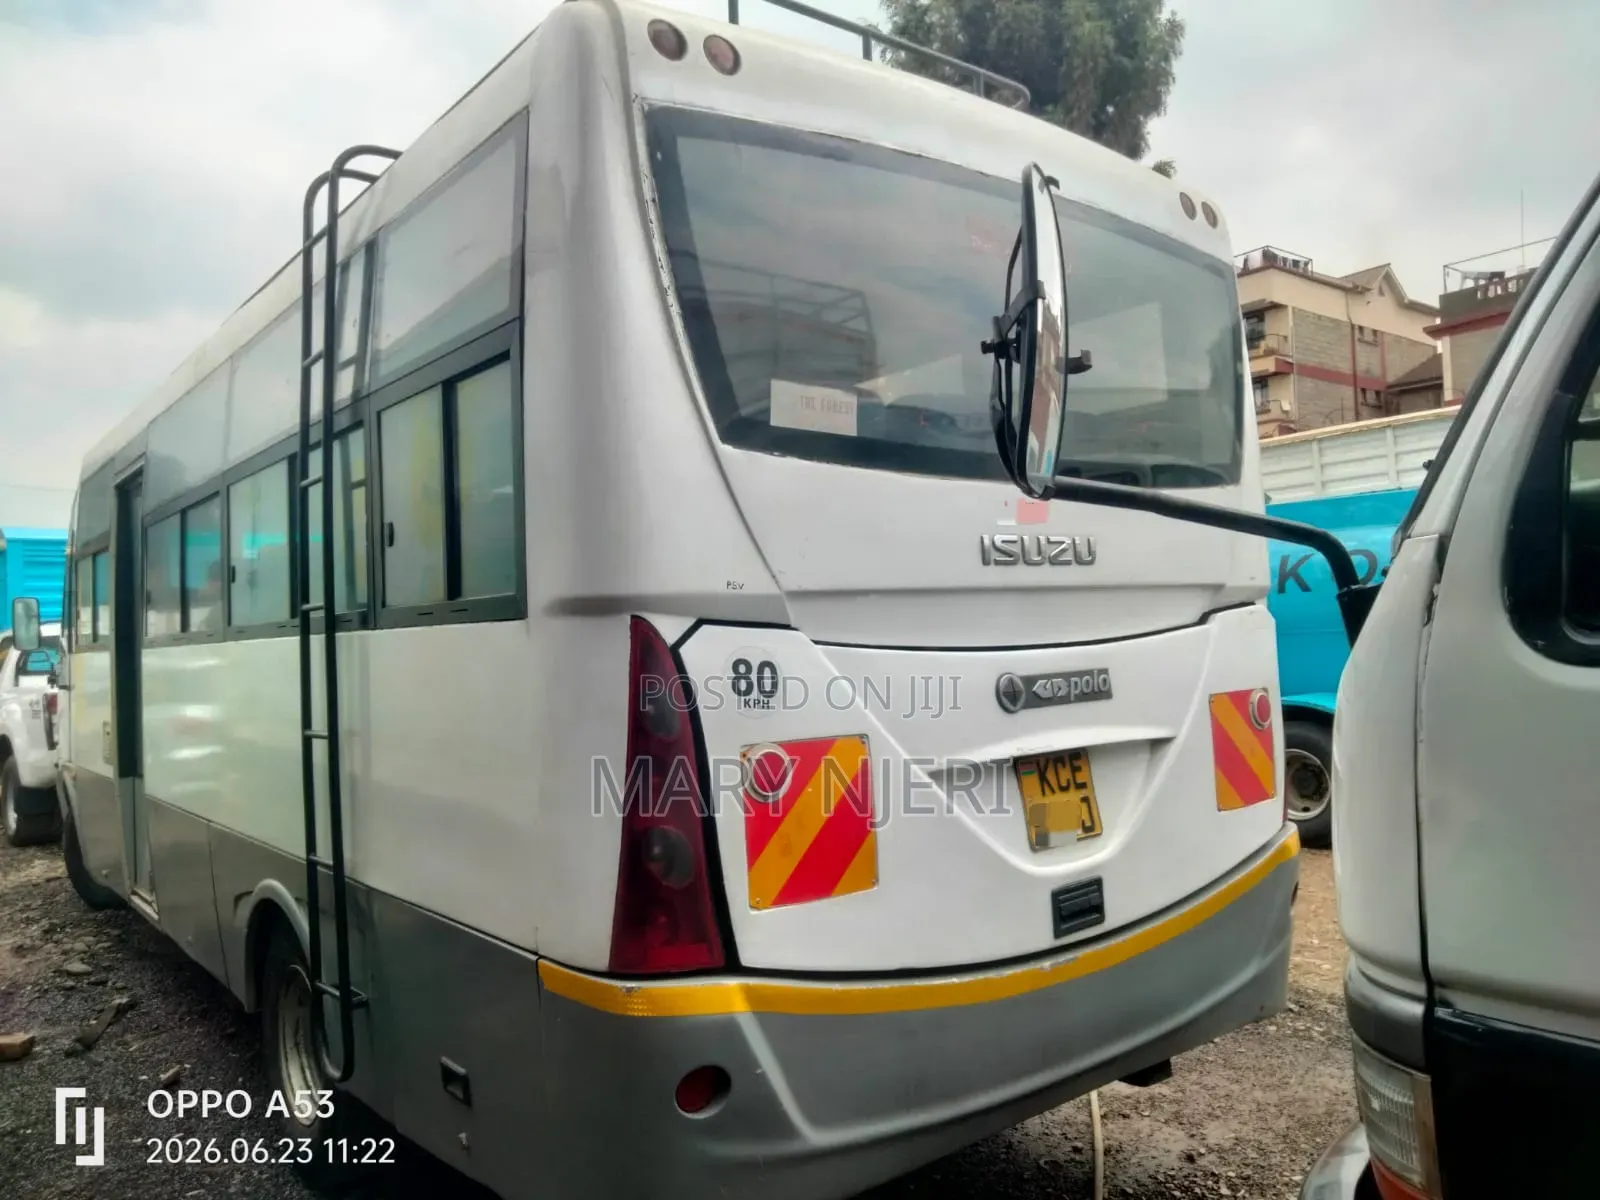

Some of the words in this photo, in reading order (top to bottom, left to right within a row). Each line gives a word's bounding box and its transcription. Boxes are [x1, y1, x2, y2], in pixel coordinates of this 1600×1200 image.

[980, 534, 1097, 567] ISUZU
[731, 658, 779, 699] 80
[1069, 669, 1110, 701] polo
[743, 698, 771, 709] KPH
[1036, 752, 1088, 797] KCE
